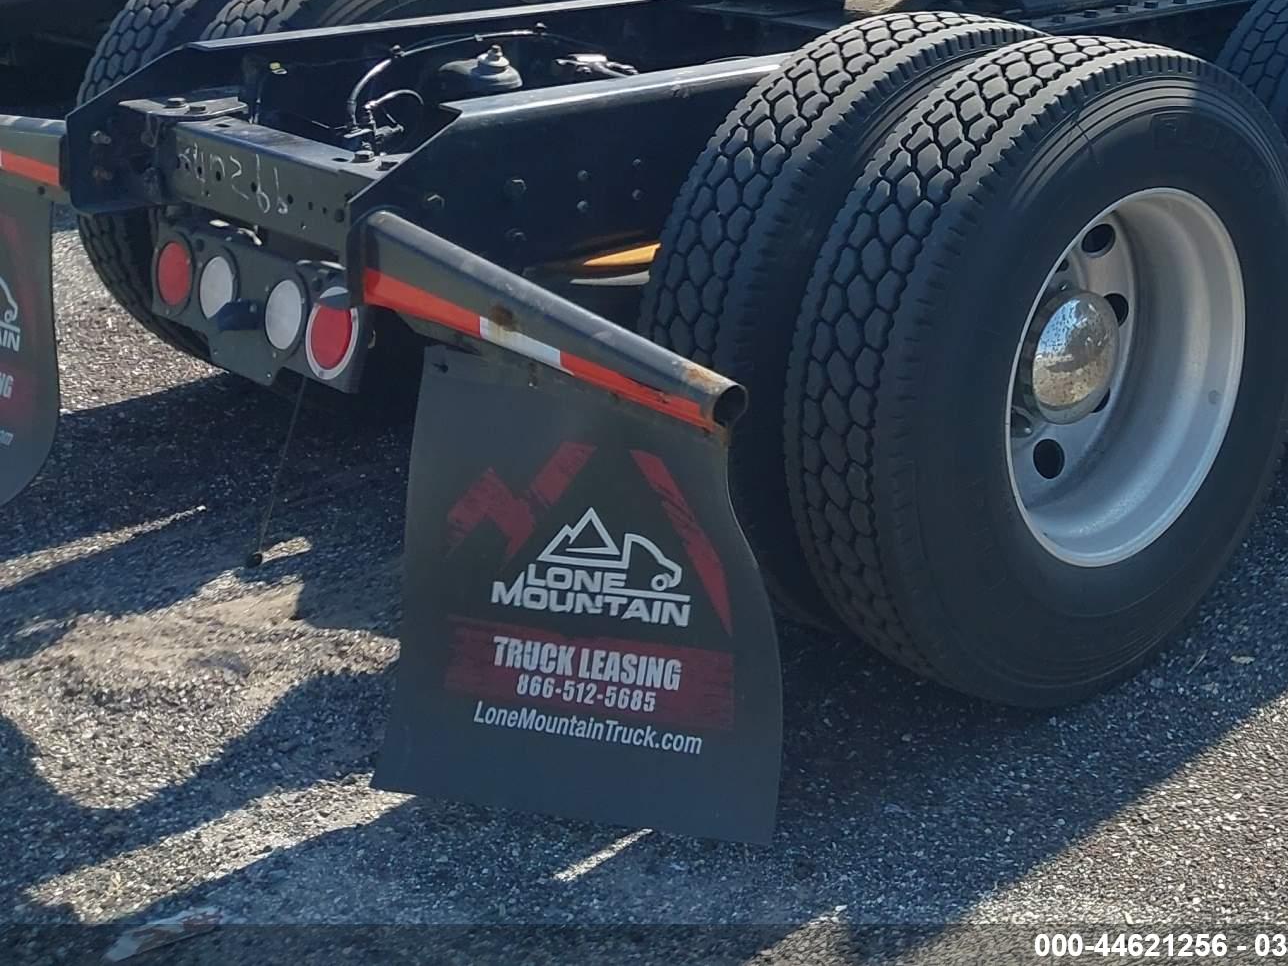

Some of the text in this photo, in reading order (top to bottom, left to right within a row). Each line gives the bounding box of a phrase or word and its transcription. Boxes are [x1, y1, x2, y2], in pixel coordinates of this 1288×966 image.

[490, 570, 691, 628] MOUNTAIN
[526, 563, 627, 593] LONE
[493, 636, 683, 691] TRUCK LEASING
[516, 673, 657, 713] 866-512-5685
[473, 701, 703, 755] LoneMountainTruck.com
